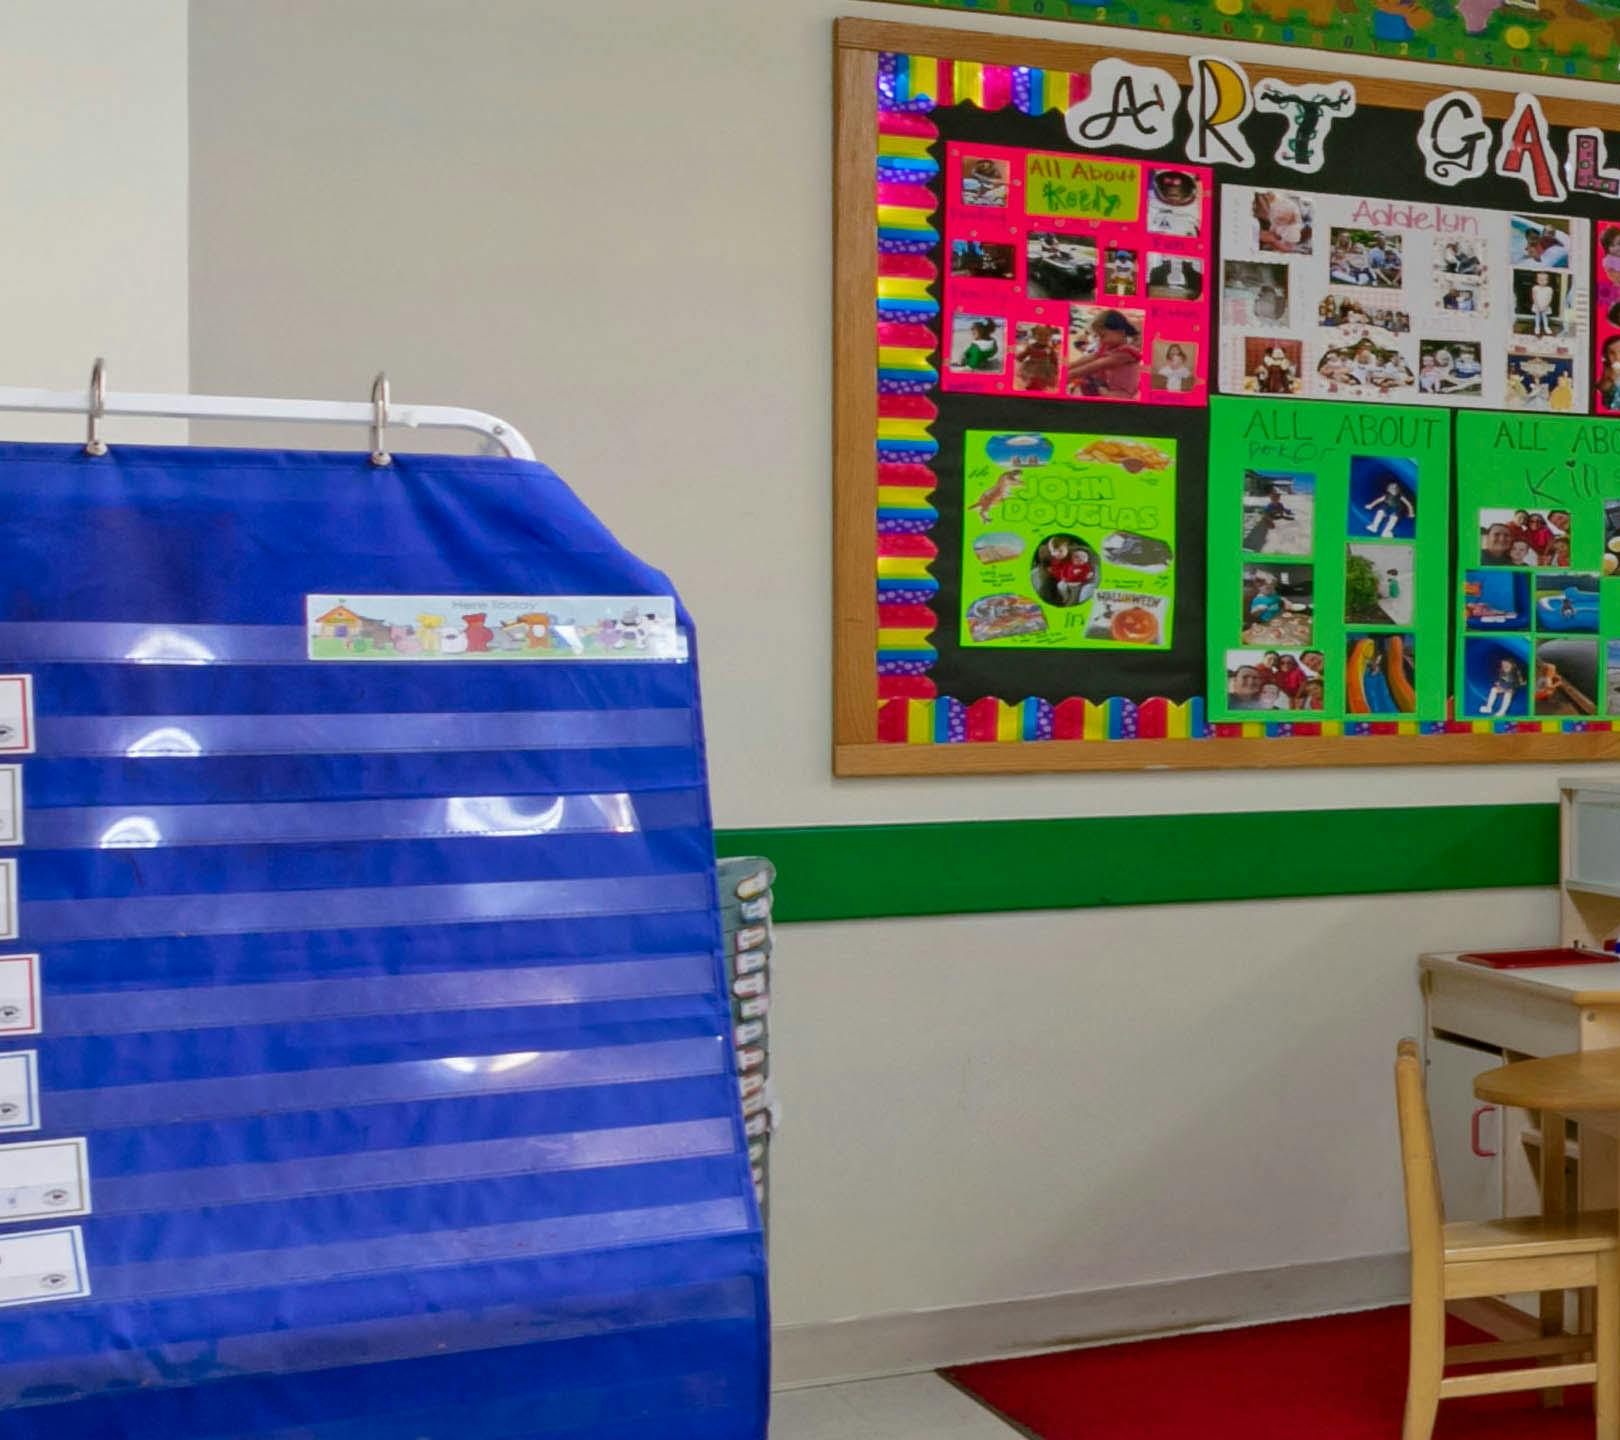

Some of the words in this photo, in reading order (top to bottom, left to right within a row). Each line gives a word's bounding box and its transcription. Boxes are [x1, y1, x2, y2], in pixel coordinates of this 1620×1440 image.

[1079, 60, 1351, 164] ART
[1030, 160, 1059, 180] All
[1072, 162, 1137, 182] About
[1243, 408, 1313, 442] ALL
[1336, 413, 1441, 451] ABOUT
[1493, 420, 1547, 452] ALL
[1017, 475, 1114, 501] JOHN
[1002, 499, 1160, 531] DOUGLAS
